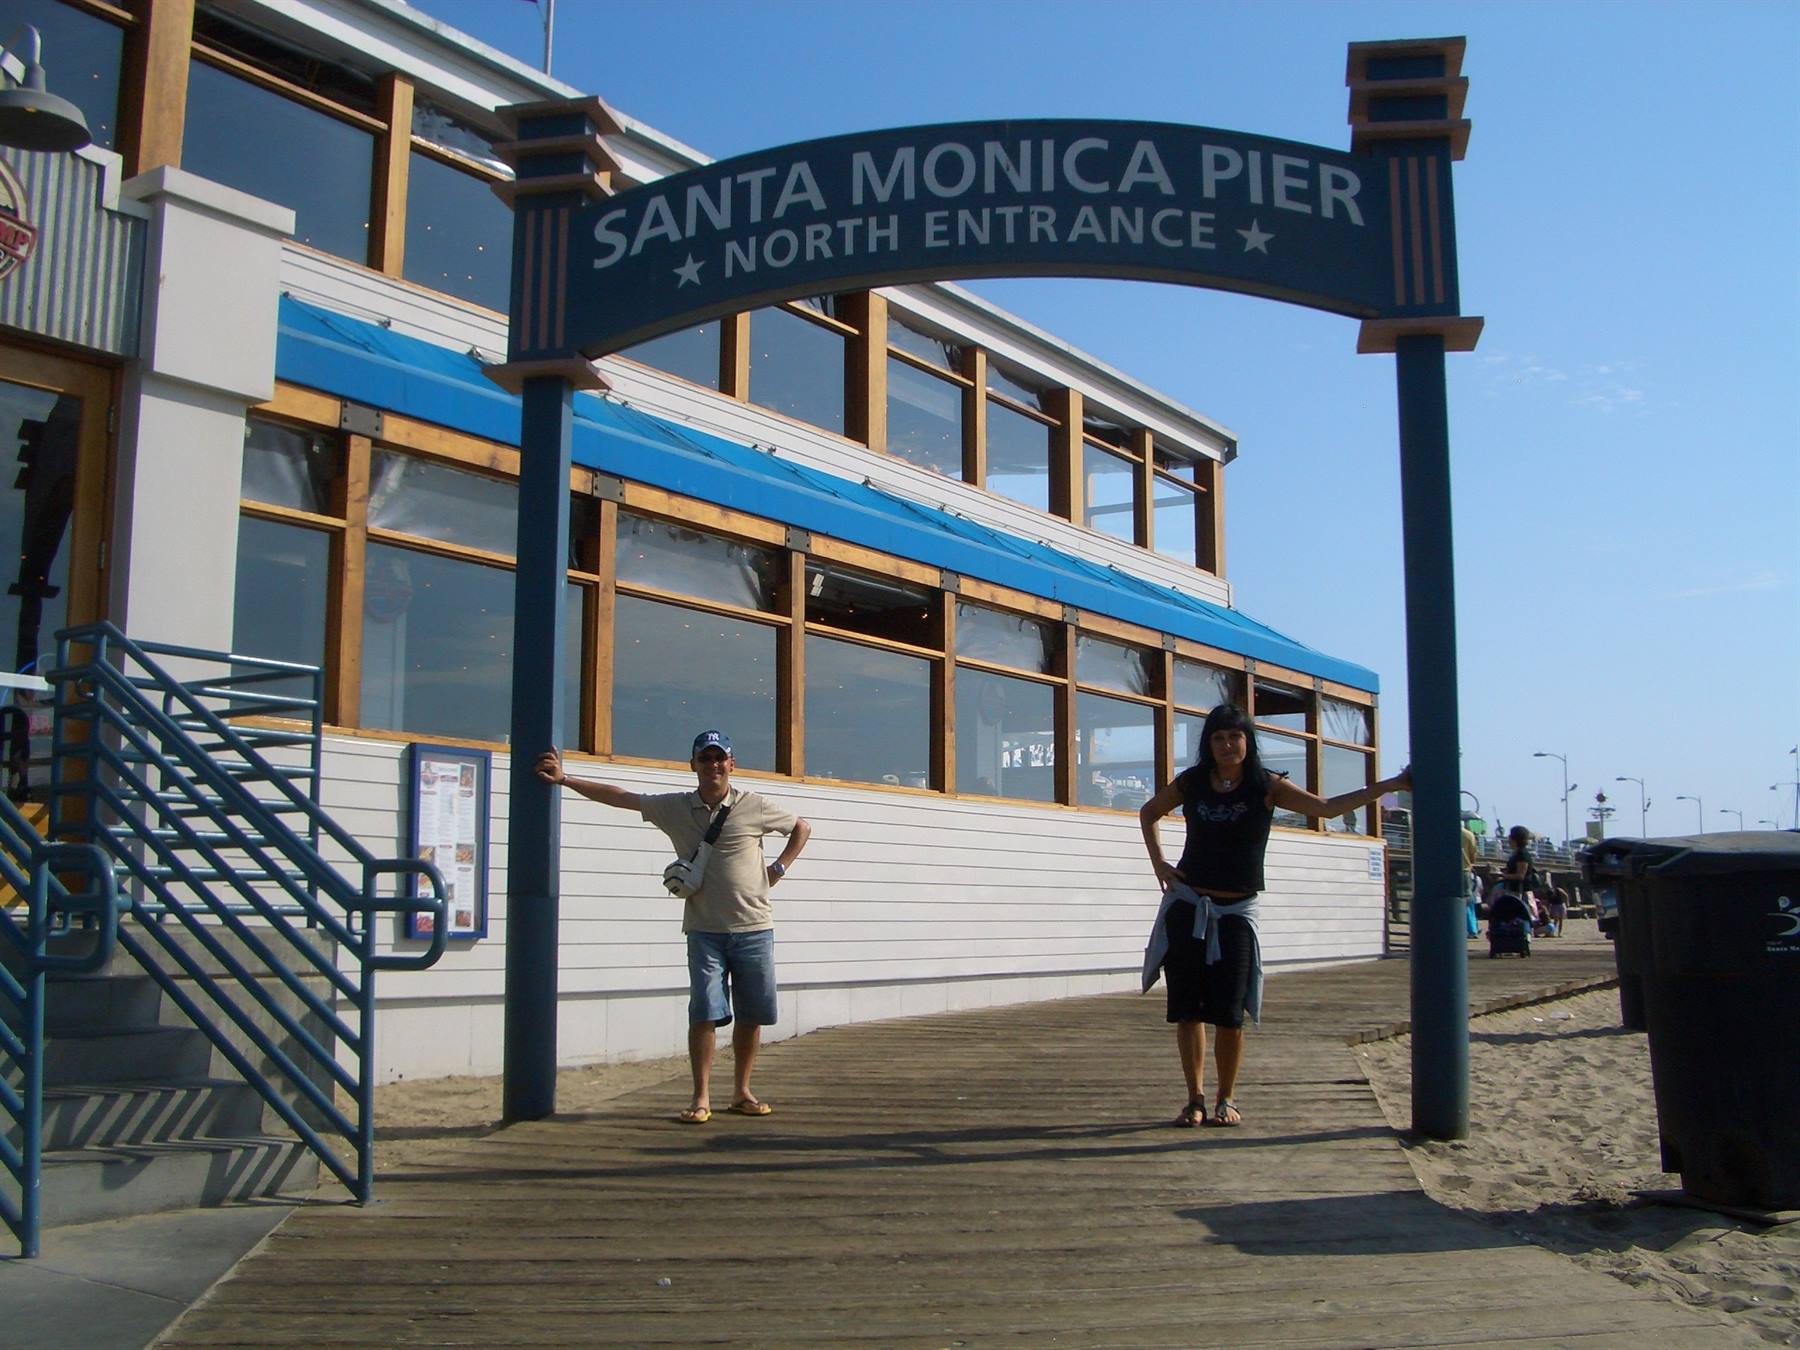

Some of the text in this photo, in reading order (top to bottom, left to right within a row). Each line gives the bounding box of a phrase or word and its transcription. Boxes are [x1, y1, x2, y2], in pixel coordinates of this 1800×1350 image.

[593, 137, 1365, 269] SANTA MONICA PIER
[725, 205, 1216, 278] NORTH ENTRANCE
